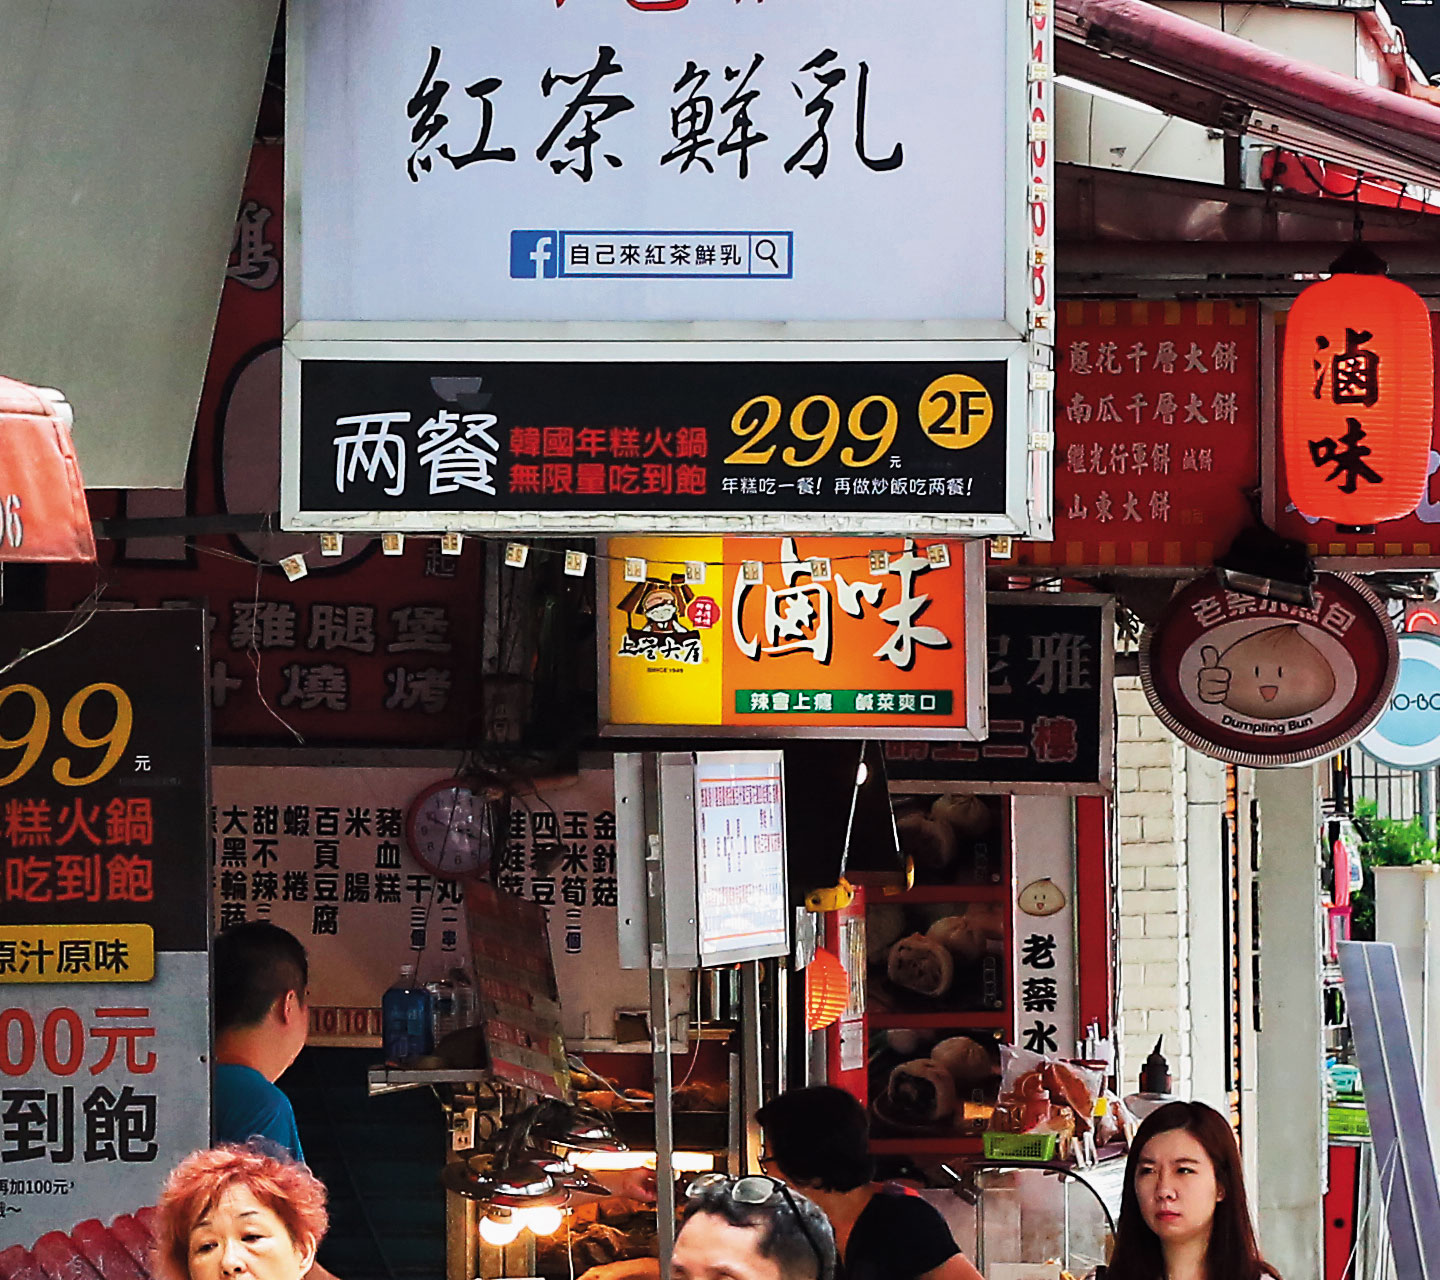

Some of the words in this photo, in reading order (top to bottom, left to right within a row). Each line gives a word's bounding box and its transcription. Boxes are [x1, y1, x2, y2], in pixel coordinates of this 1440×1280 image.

[405, 46, 904, 182] 紅茶鮮乳
[569, 243, 742, 268] 自己來紅茶鮮乳
[509, 426, 708, 461] 韓國年糕火鍋
[928, 390, 986, 433] 2F
[1067, 392, 1238, 424] 南瓜千層大餅
[1309, 327, 1383, 494] 滷味
[509, 463, 707, 497] 無限量吃到飽
[1069, 491, 1170, 522] 山東大餅
[210, 600, 451, 653] 雞腿堡
[731, 537, 952, 666] 滷味
[1221, 715, 1285, 735] Dumpling
[1288, 716, 1312, 731] Bun
[283, 807, 310, 903] 蝦捲
[312, 807, 340, 936] 百頁豆腐
[344, 807, 371, 903] 米腸
[374, 807, 403, 904] 豬血糕
[592, 810, 618, 908] 金針菇
[1022, 933, 1058, 1055] 老蔡水
